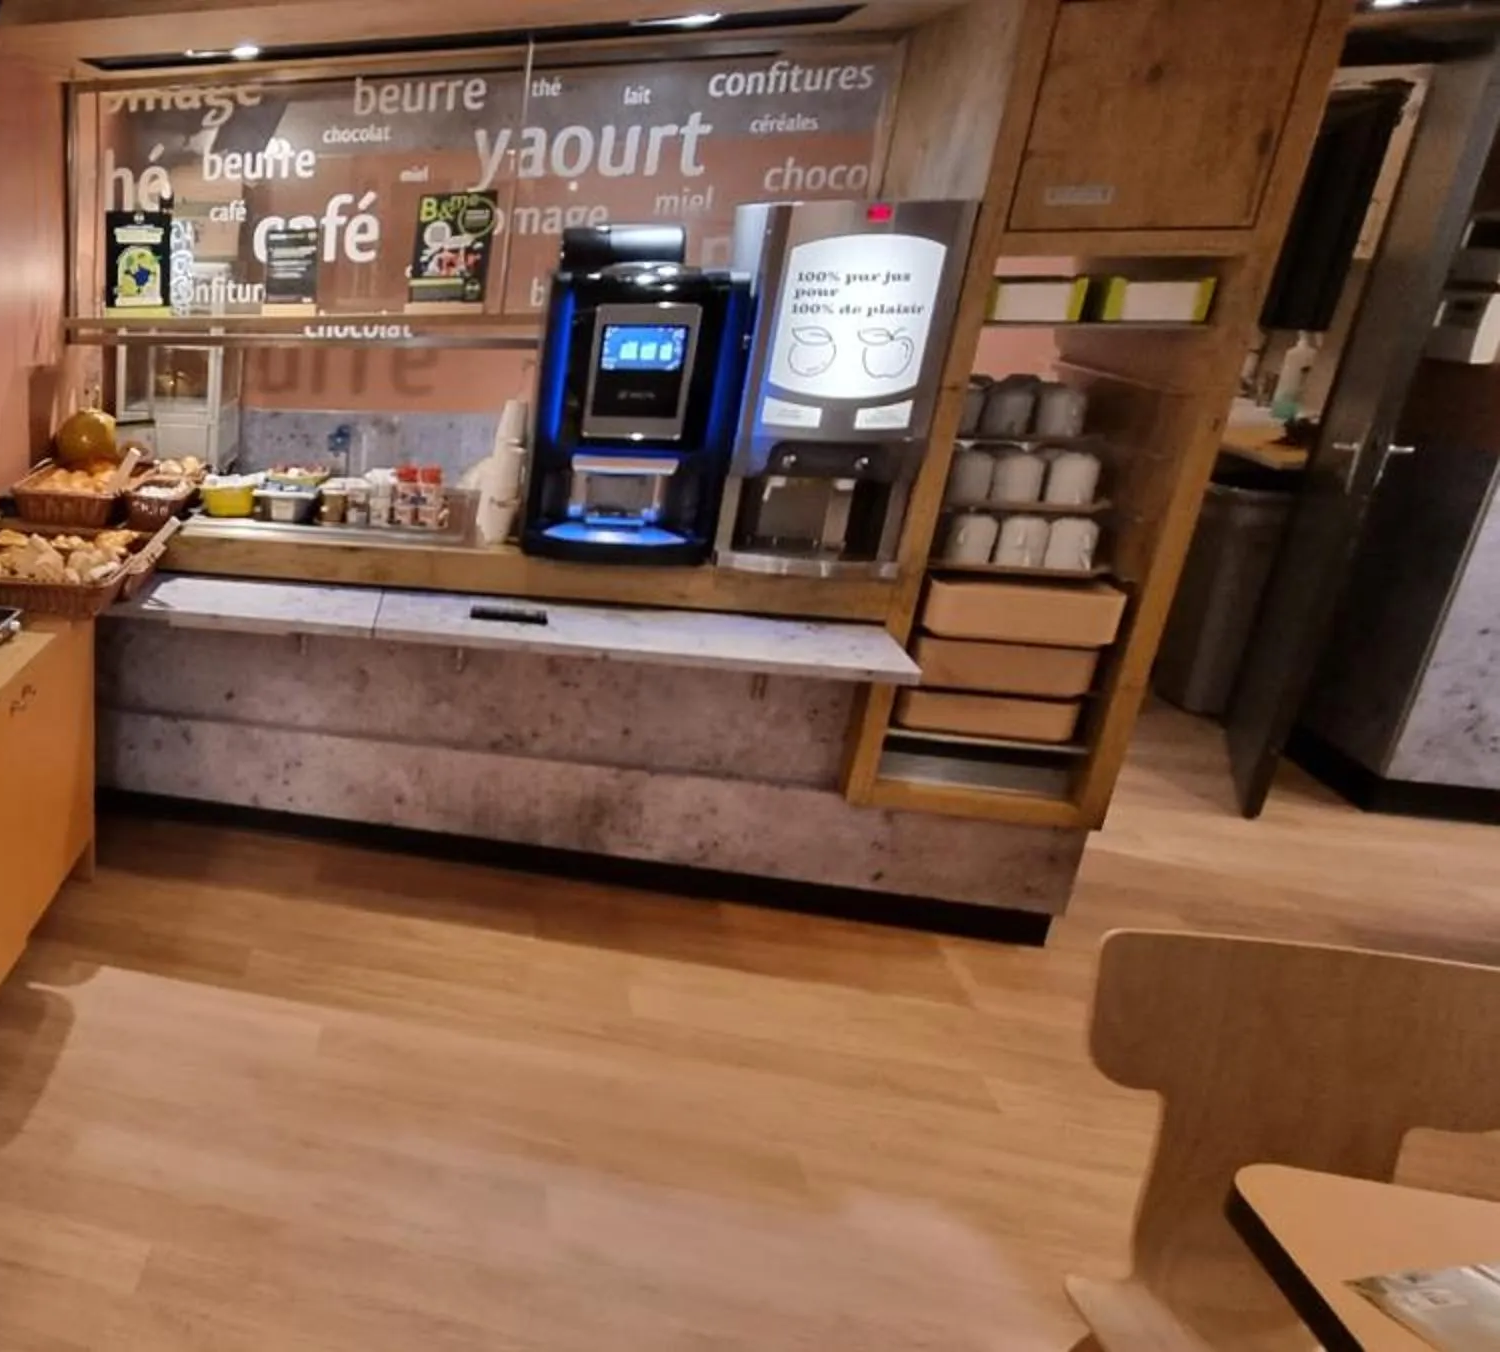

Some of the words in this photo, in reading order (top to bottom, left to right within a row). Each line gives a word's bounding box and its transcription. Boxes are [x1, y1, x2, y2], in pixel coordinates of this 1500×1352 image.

[531, 76, 562, 98] thé
[708, 60, 876, 98] confitures
[355, 77, 487, 116] beurre
[623, 85, 651, 105] lait
[322, 124, 392, 144] chocolat
[750, 112, 820, 134] céréales
[471, 111, 713, 192] yaourt
[764, 157, 870, 192] choco
[209, 200, 248, 222] café
[653, 184, 715, 216] miel
[867, 303, 925, 318] plaisir
